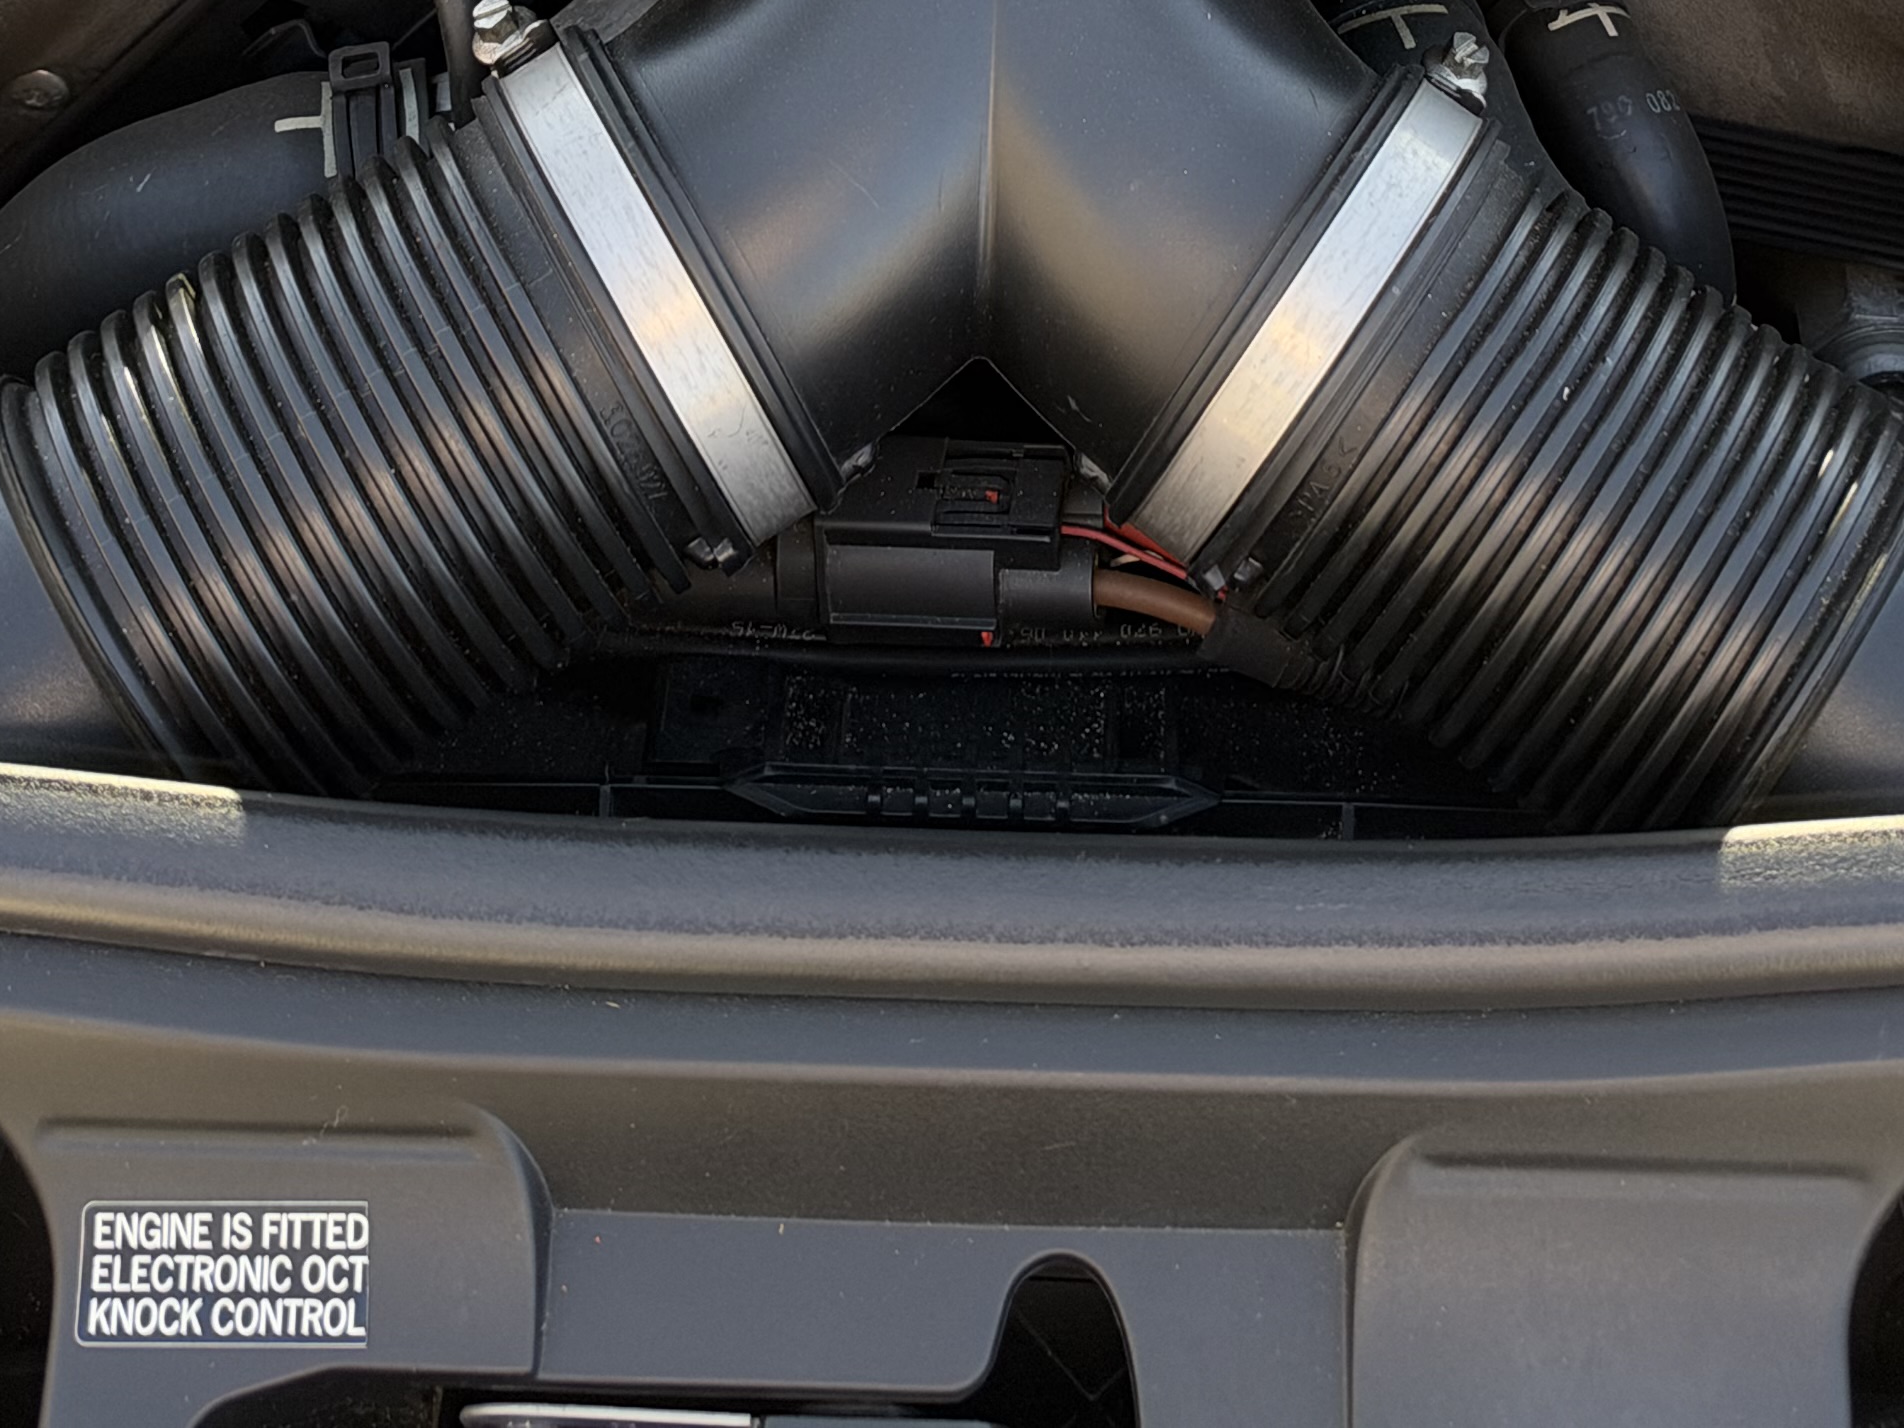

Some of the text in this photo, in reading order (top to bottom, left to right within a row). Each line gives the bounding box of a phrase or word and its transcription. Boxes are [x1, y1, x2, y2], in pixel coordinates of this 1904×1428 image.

[92, 1212, 369, 1250] ENGINE IS FITTED
[90, 1254, 369, 1293] ELECTRONIC OCT
[87, 1297, 366, 1336] KNOCK CONTROL
